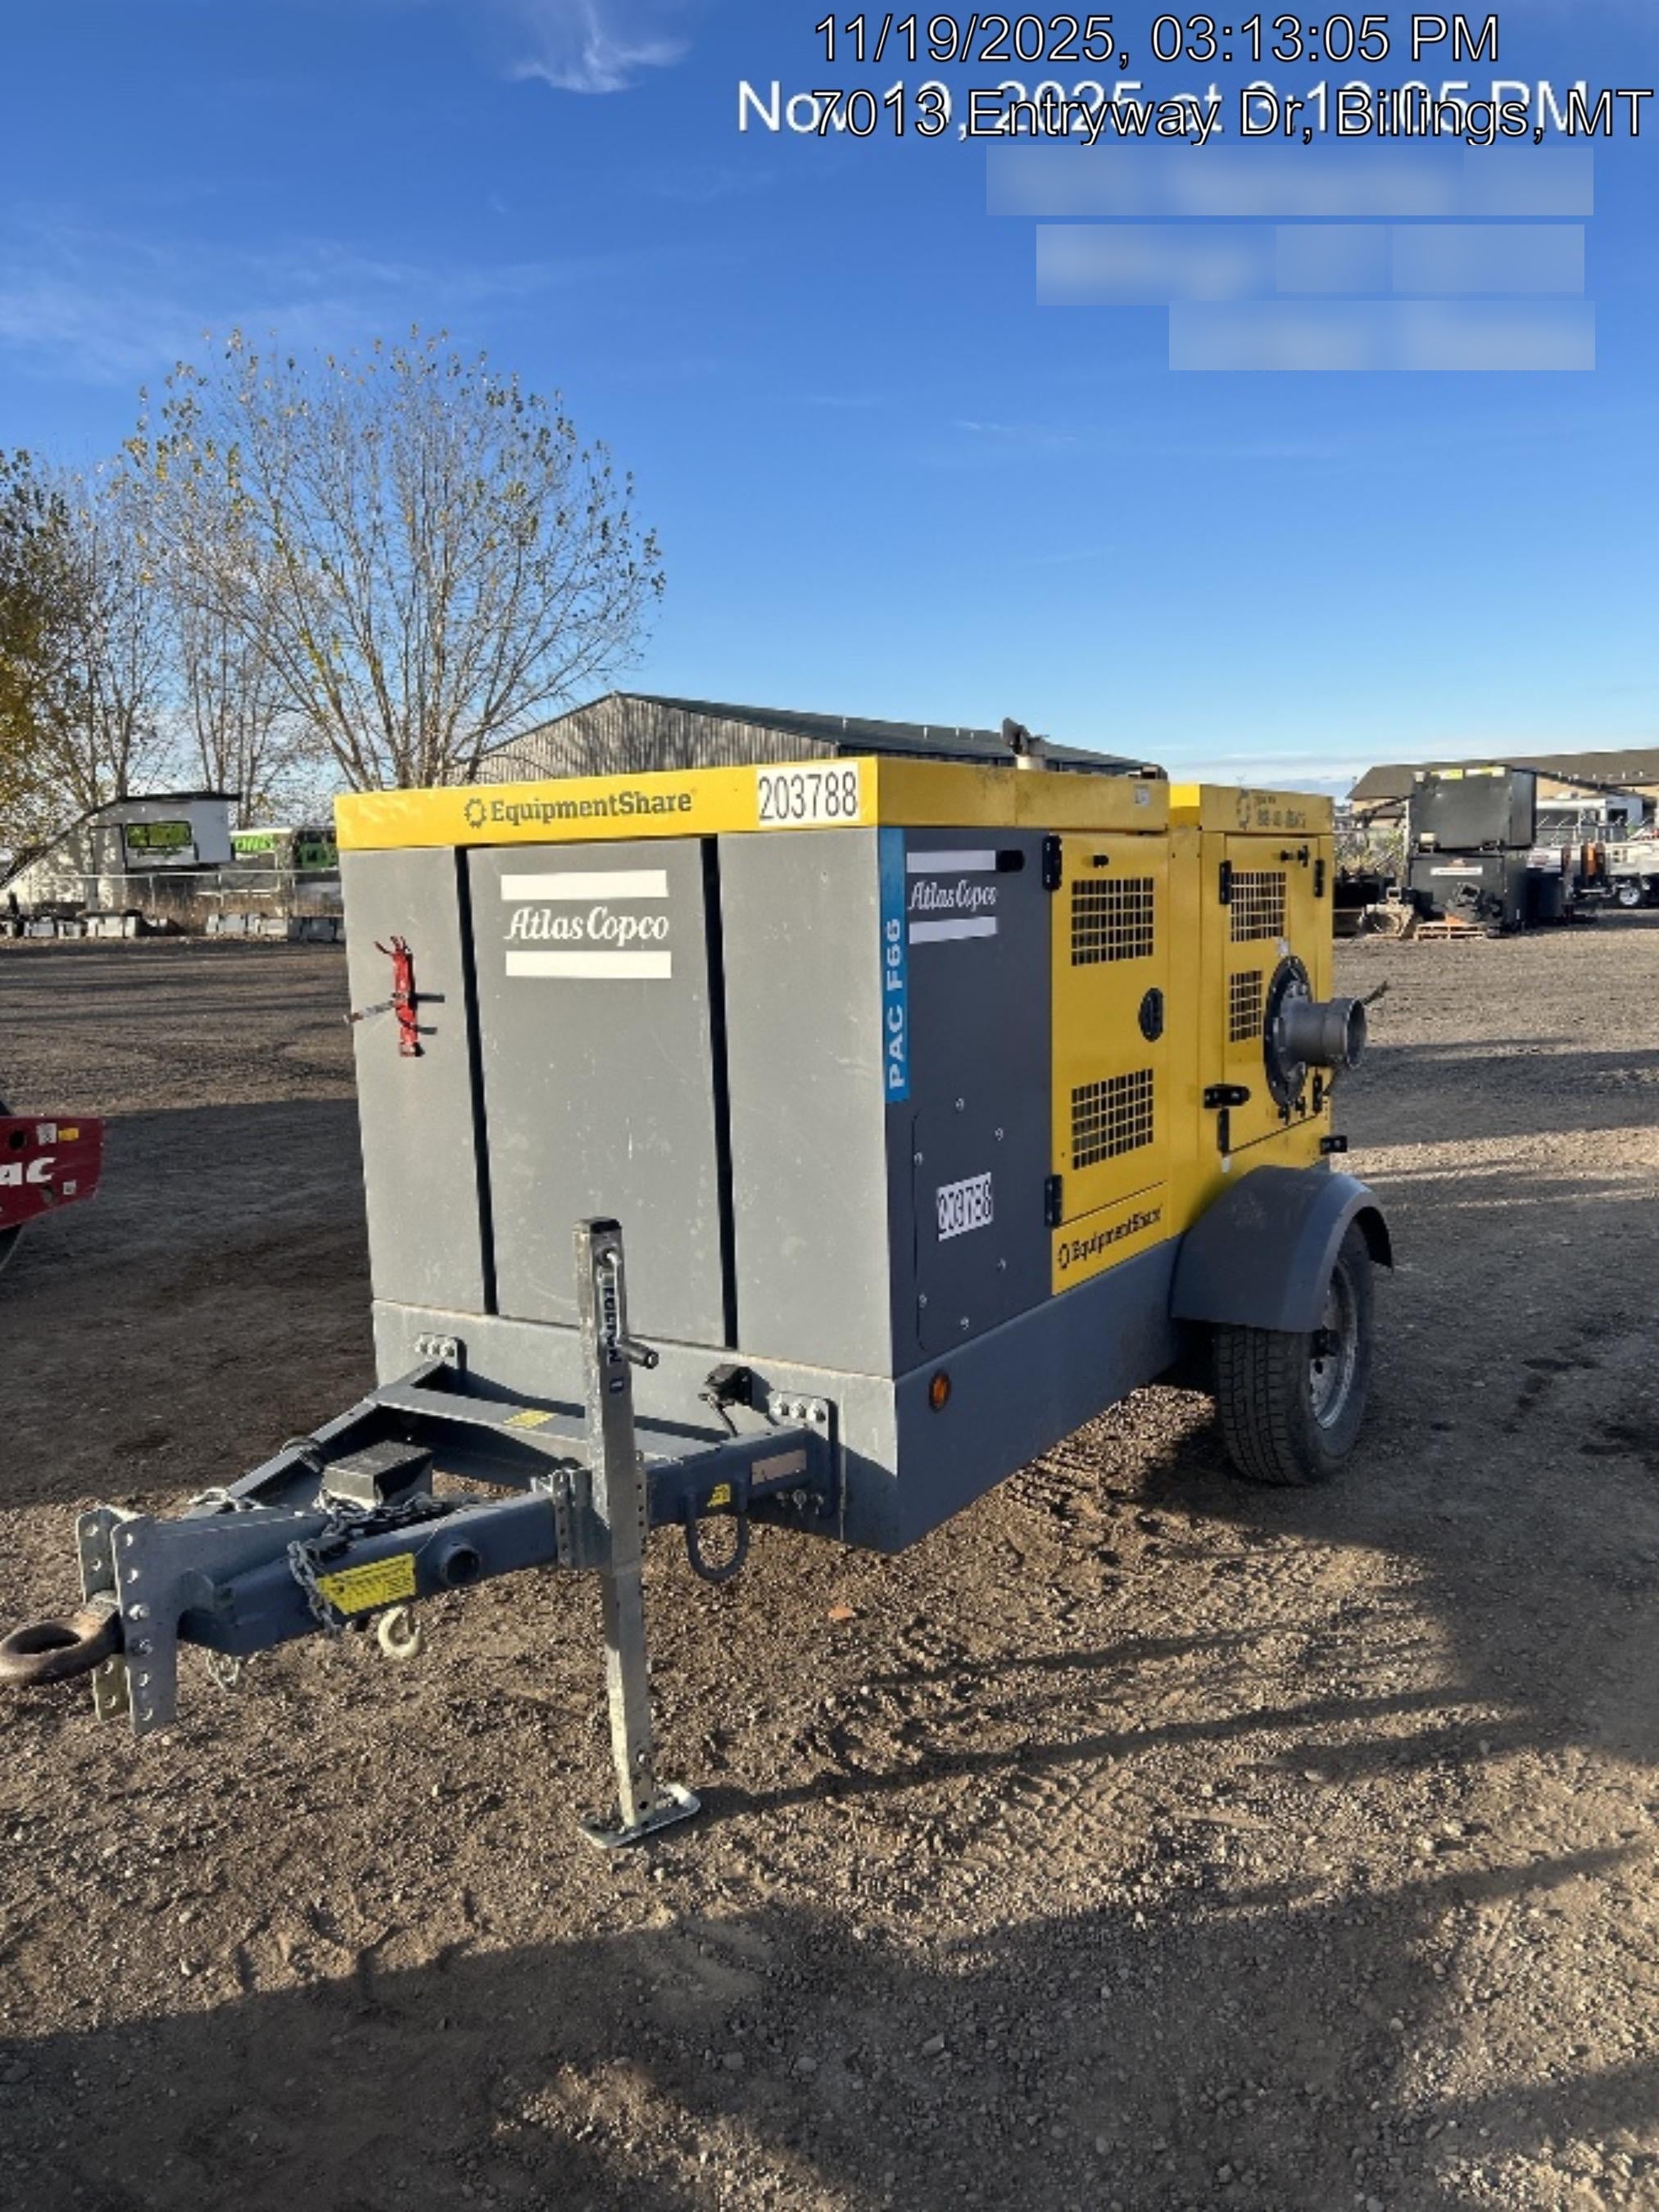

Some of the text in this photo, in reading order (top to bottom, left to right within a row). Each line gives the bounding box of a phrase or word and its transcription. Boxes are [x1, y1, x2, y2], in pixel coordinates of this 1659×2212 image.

[490, 791, 692, 826] EquipmentShare
[759, 771, 858, 820] 203788
[503, 906, 669, 947] Atlas Copco
[886, 918, 905, 1089] PAC F66
